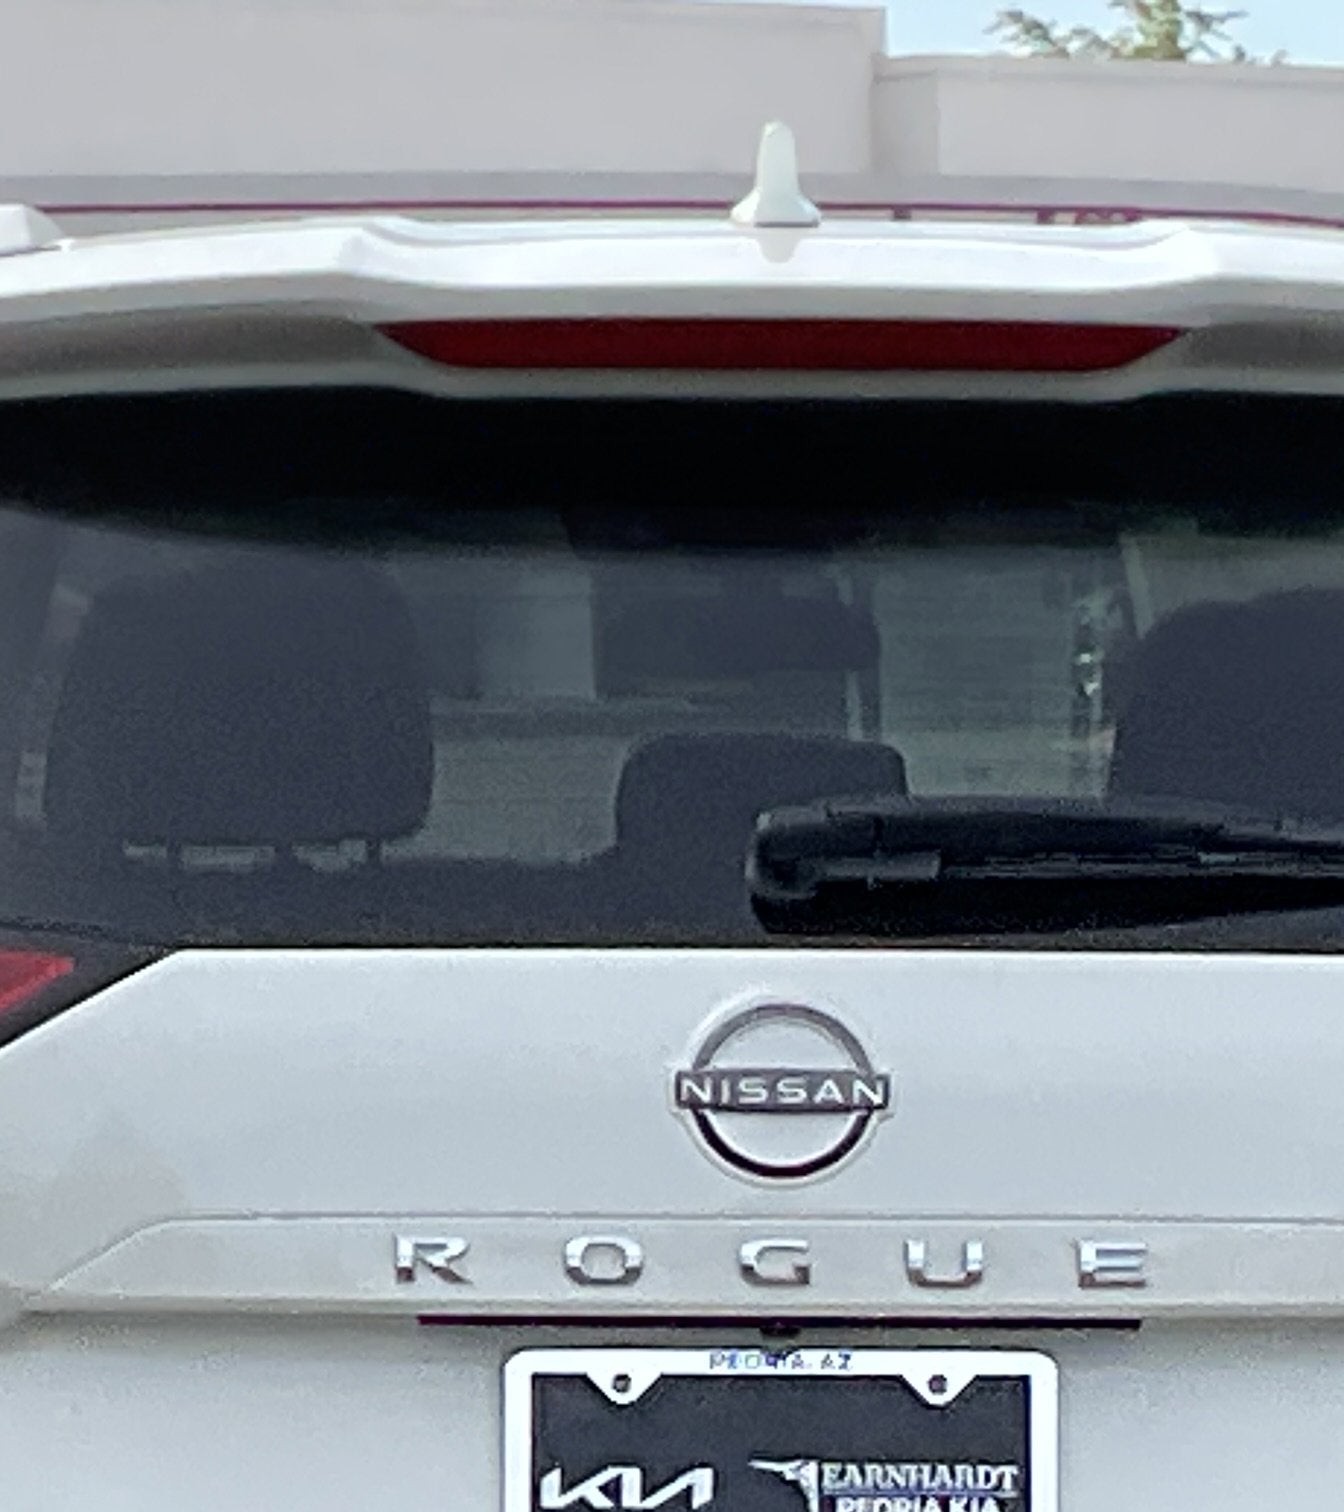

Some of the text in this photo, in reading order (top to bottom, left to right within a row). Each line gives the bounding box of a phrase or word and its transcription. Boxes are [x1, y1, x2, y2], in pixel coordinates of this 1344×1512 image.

[681, 1077, 885, 1104] NISSAN
[394, 1238, 1149, 1289] ROGUE
[540, 1467, 714, 1509] KIA
[820, 1462, 1018, 1490] EARNHARDT
